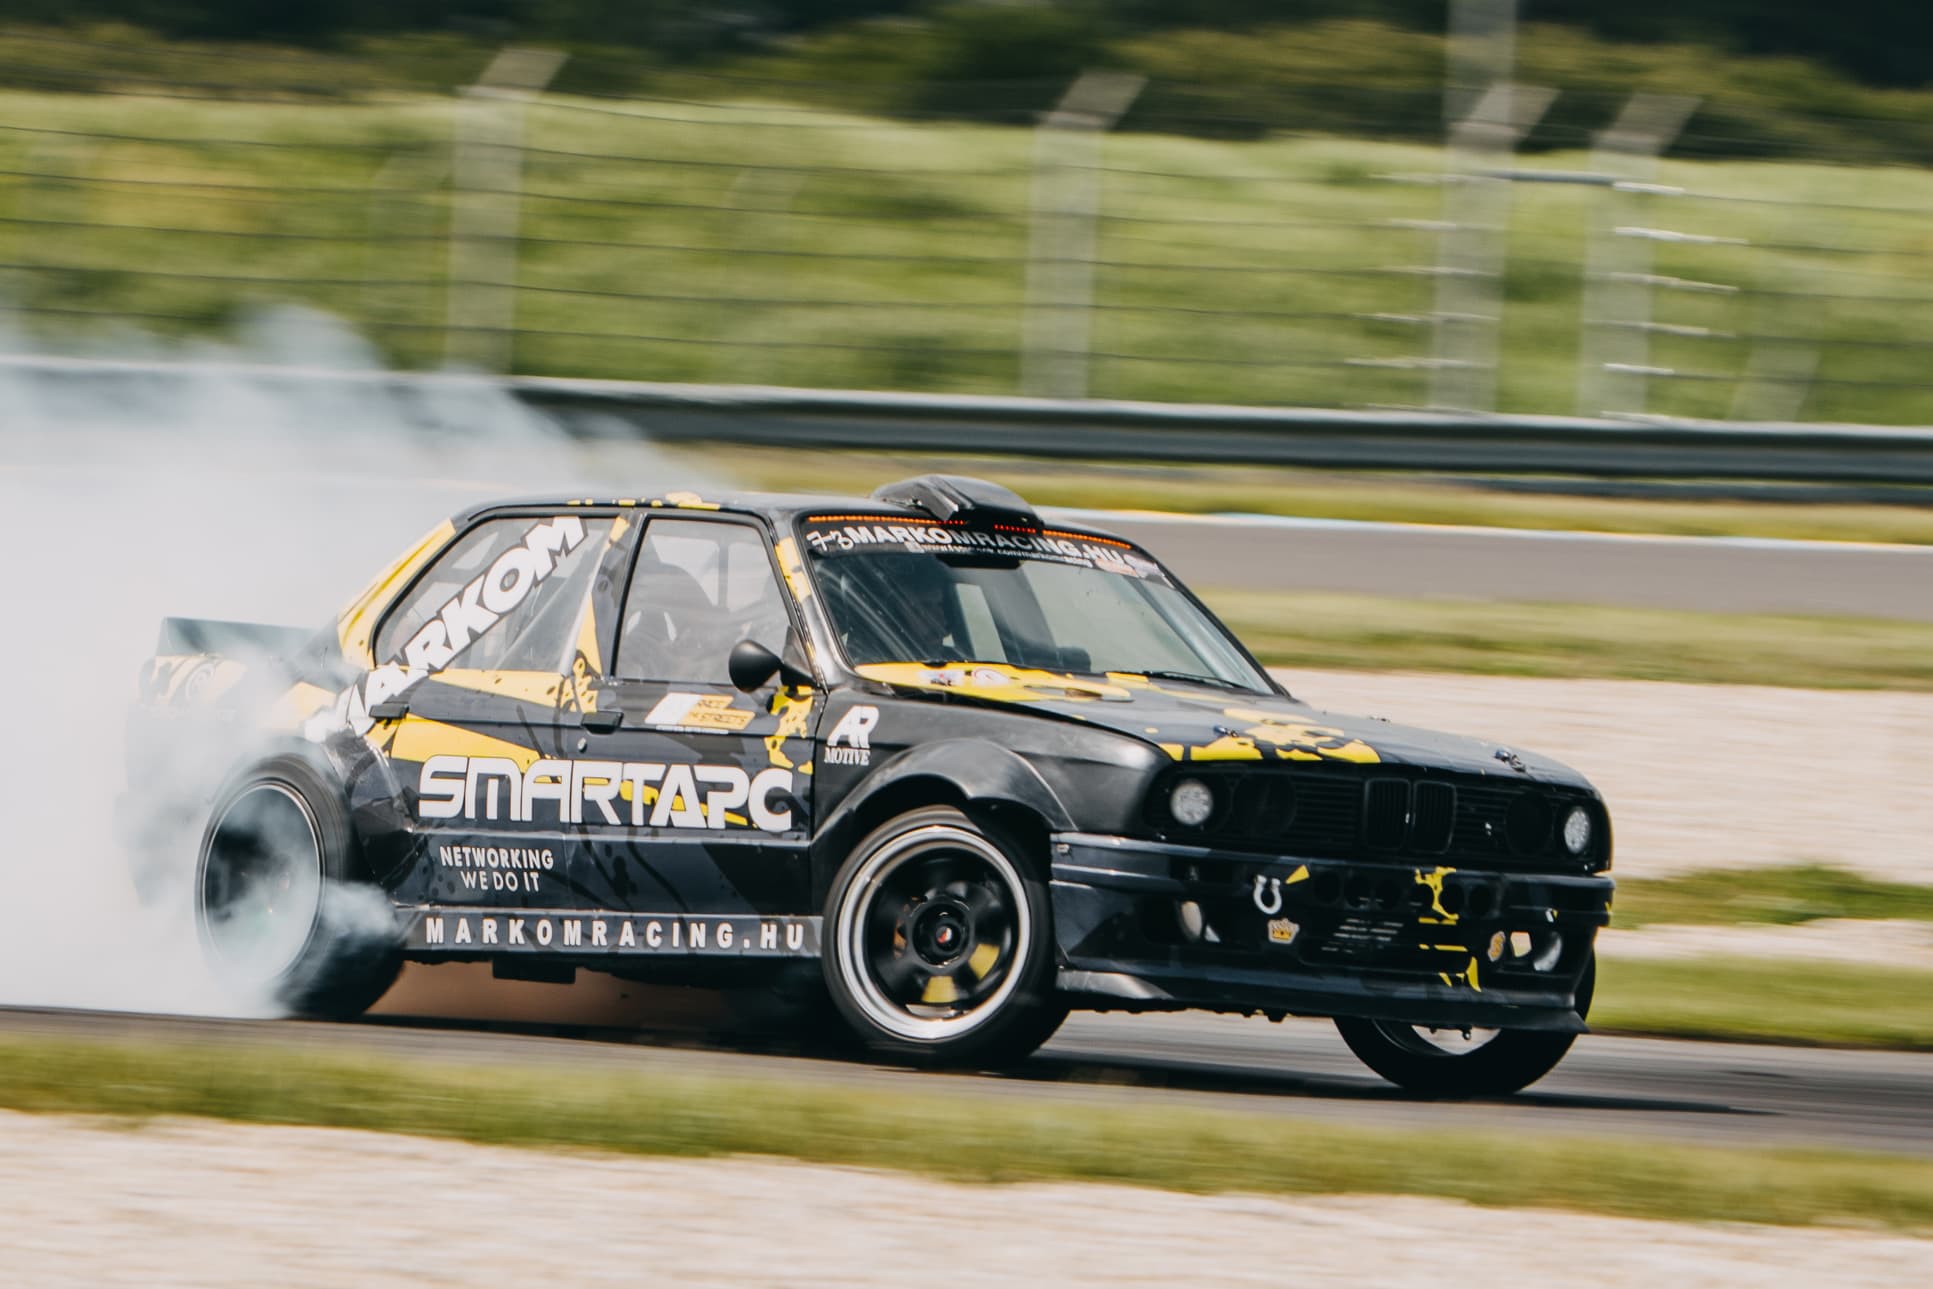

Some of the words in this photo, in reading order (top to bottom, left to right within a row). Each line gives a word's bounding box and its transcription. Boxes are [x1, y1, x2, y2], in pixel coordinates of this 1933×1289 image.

[304, 516, 588, 742] MARKOM
[824, 747, 871, 766] MOTIVE
[418, 755, 793, 832] SMARTAPC
[440, 846, 554, 870] NETWORKING
[461, 870, 489, 890] WE
[493, 872, 518, 891] DO
[524, 871, 539, 892] IT
[425, 916, 803, 950] MARKOMRACING.HU
